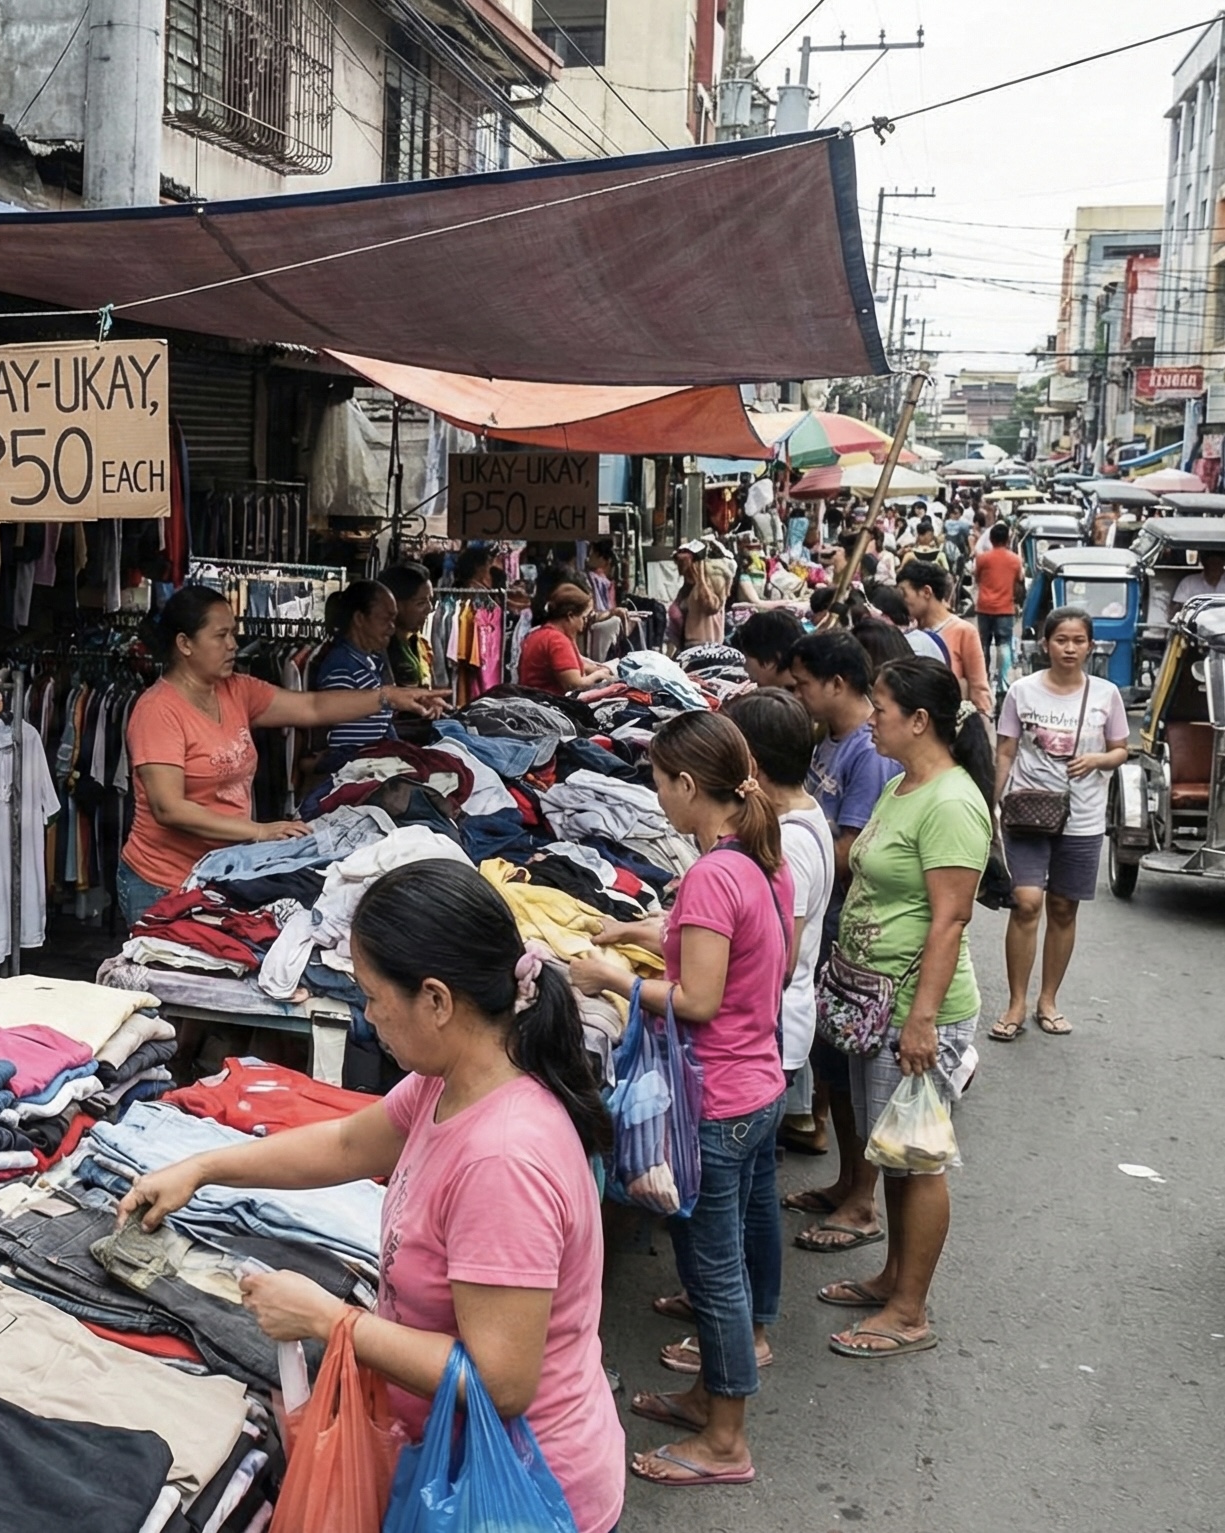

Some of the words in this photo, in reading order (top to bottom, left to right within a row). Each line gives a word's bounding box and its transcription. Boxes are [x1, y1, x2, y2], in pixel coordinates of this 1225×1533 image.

[102, 460, 165, 494] EACH
[459, 456, 590, 488] UKAY-UKAY,
[461, 490, 526, 535] P50
[533, 505, 587, 530] EACH
